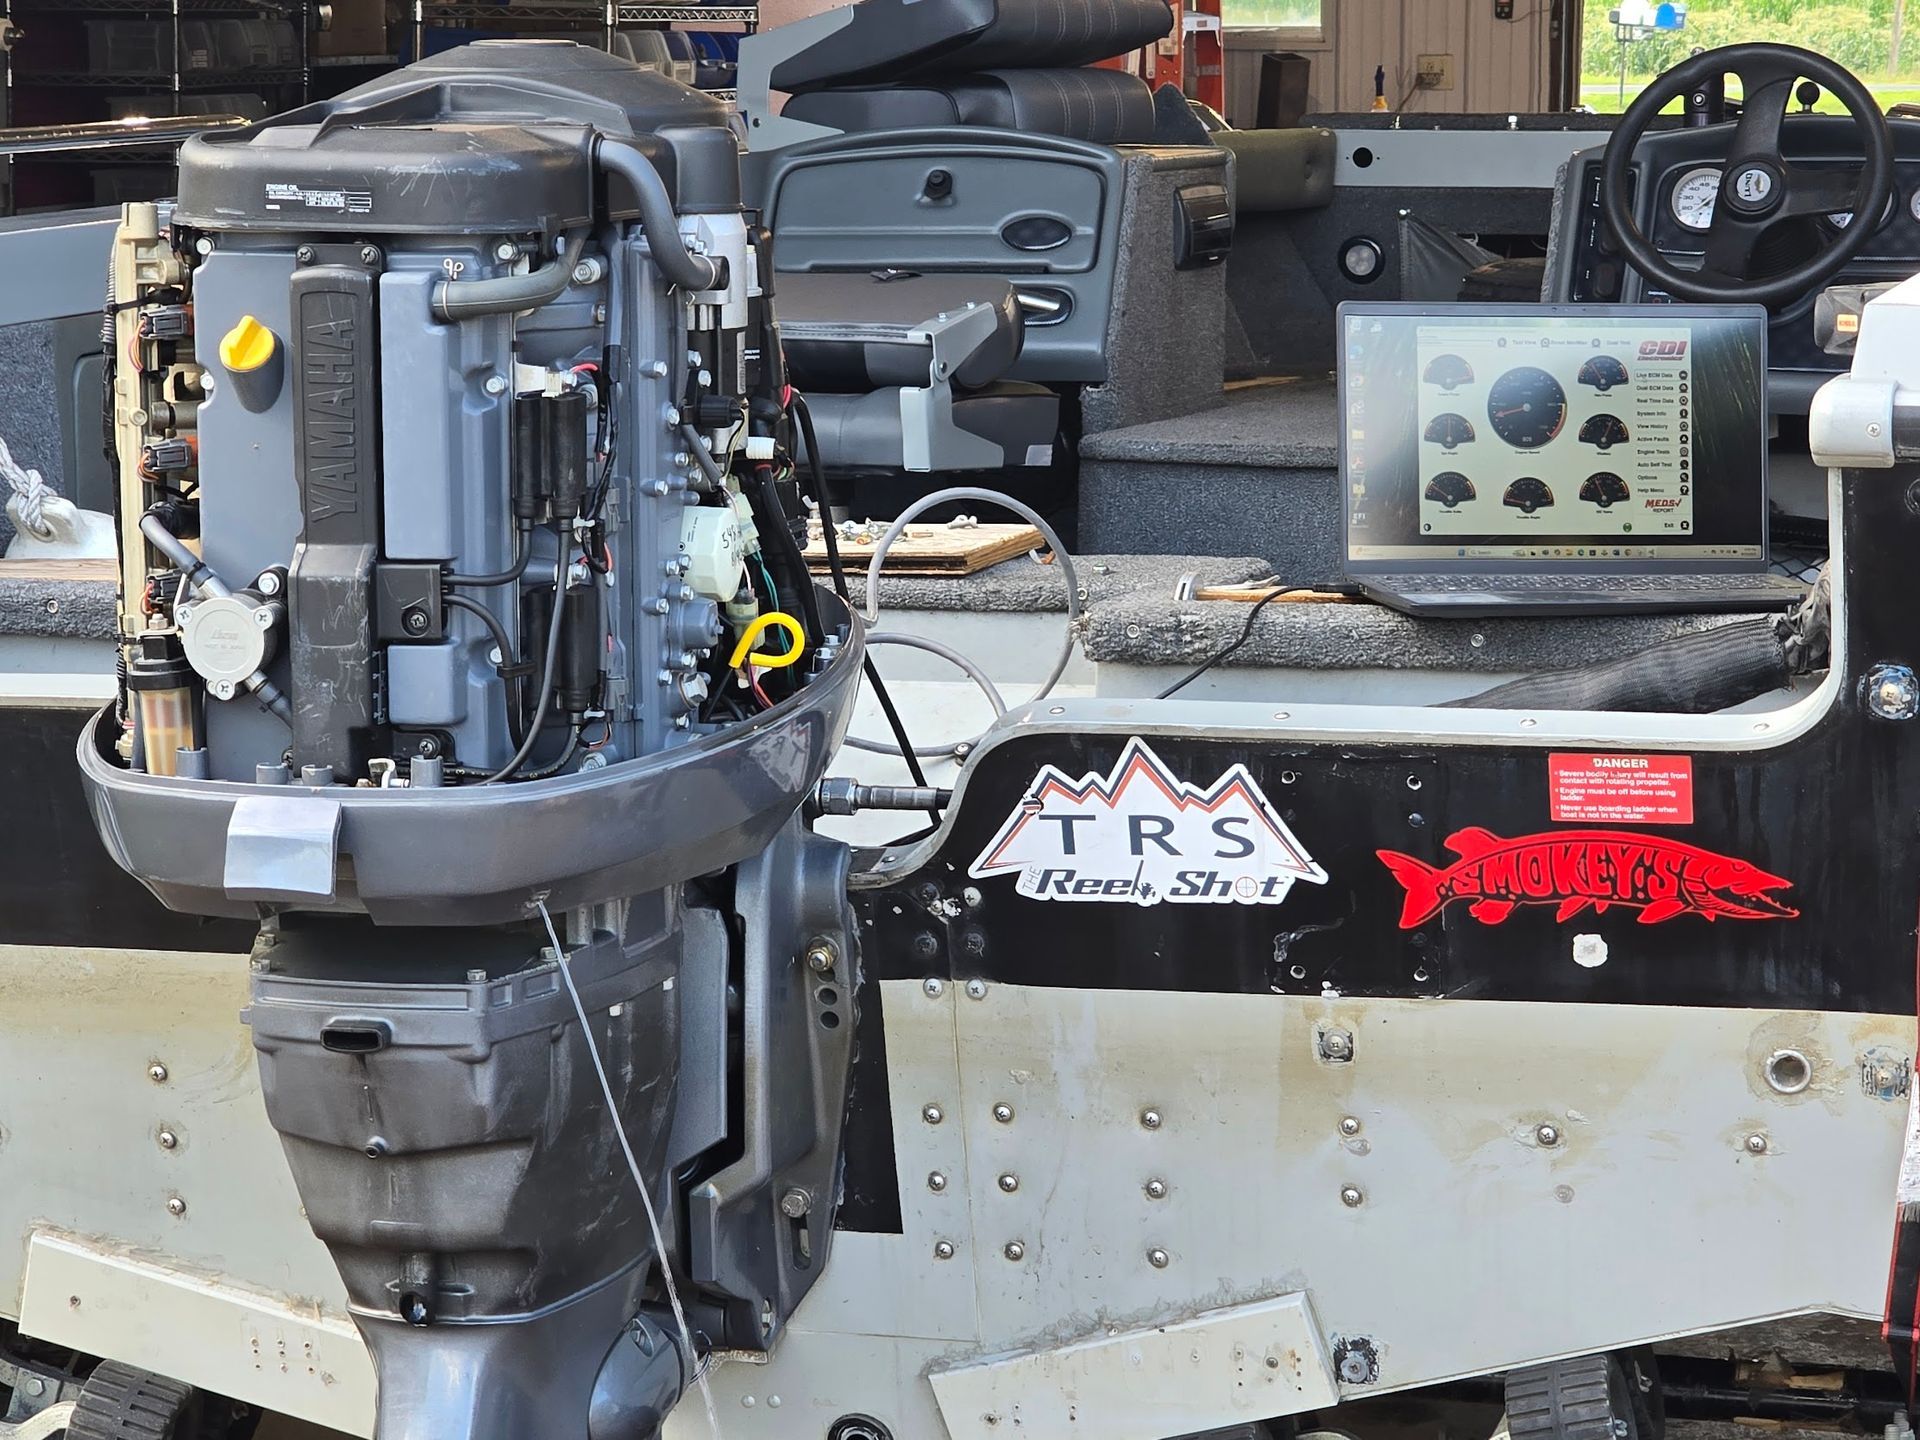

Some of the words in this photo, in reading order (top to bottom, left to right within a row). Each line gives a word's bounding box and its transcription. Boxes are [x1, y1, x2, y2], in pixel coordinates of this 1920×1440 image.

[1638, 341, 1687, 355] CDI
[307, 319, 357, 524] YAMAHA
[1593, 758, 1648, 768] DANGER
[1606, 778, 1634, 786] rotating
[1560, 787, 1585, 795] Engine
[1598, 805, 1631, 813] boarding
[1452, 841, 1682, 899] SMOKEY'S
[1022, 866, 1041, 891] THE
[1035, 861, 1154, 898] Reel
[1169, 870, 1286, 898] Shot
